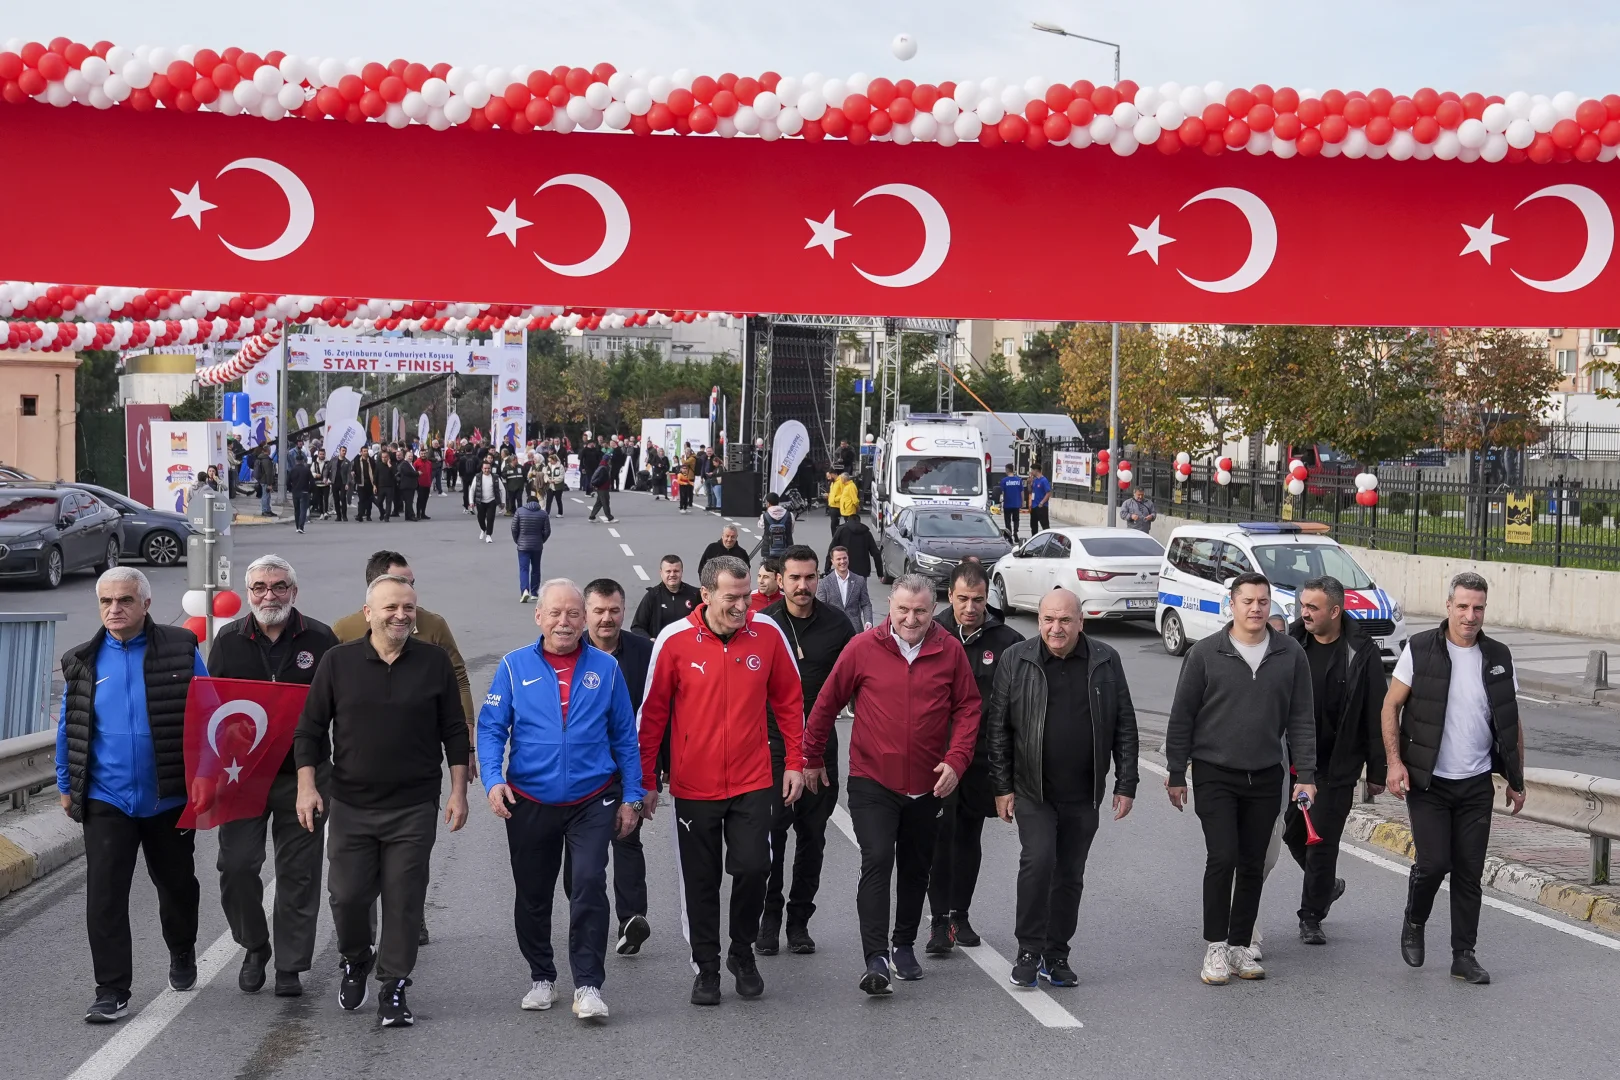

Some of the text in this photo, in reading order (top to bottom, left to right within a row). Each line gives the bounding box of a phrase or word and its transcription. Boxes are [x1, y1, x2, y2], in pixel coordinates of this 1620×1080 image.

[337, 349, 382, 358] Zeytinburnu
[384, 350, 427, 359] Cumhuriyet
[428, 351, 454, 360] Koşusu
[323, 358, 379, 370] START
[397, 359, 454, 372] FINISH
